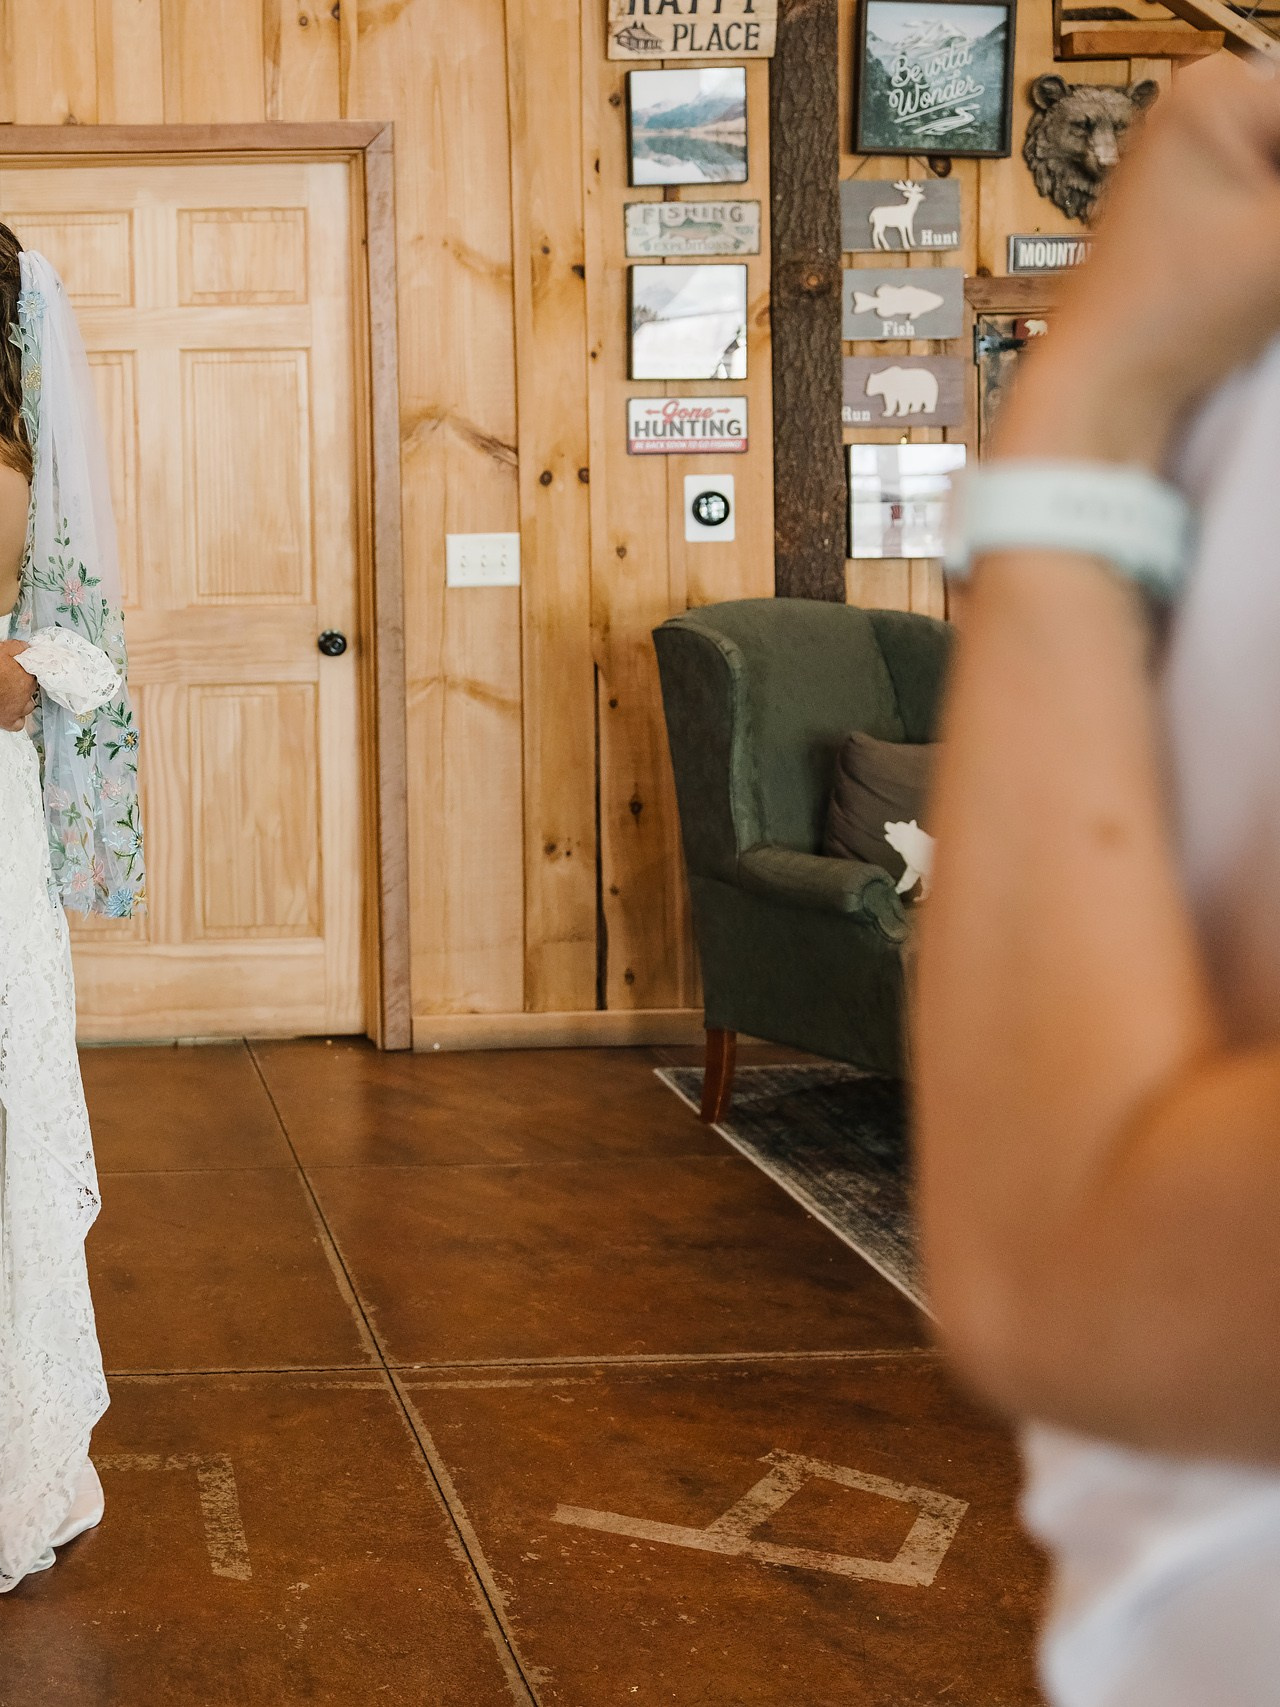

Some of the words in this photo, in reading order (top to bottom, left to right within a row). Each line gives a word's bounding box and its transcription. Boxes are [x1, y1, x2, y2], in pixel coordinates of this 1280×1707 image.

[671, 22, 760, 51] PLACE
[891, 54, 923, 87] Be
[923, 43, 974, 77] wild
[889, 75, 983, 117] Wonder
[642, 206, 743, 224] FISHING
[921, 229, 958, 245] Hunt
[1019, 242, 1092, 267] MOUNTA
[882, 321, 915, 336] Fish
[661, 399, 714, 425] Gone
[842, 407, 871, 422] Run
[634, 419, 741, 437] HUNTING
